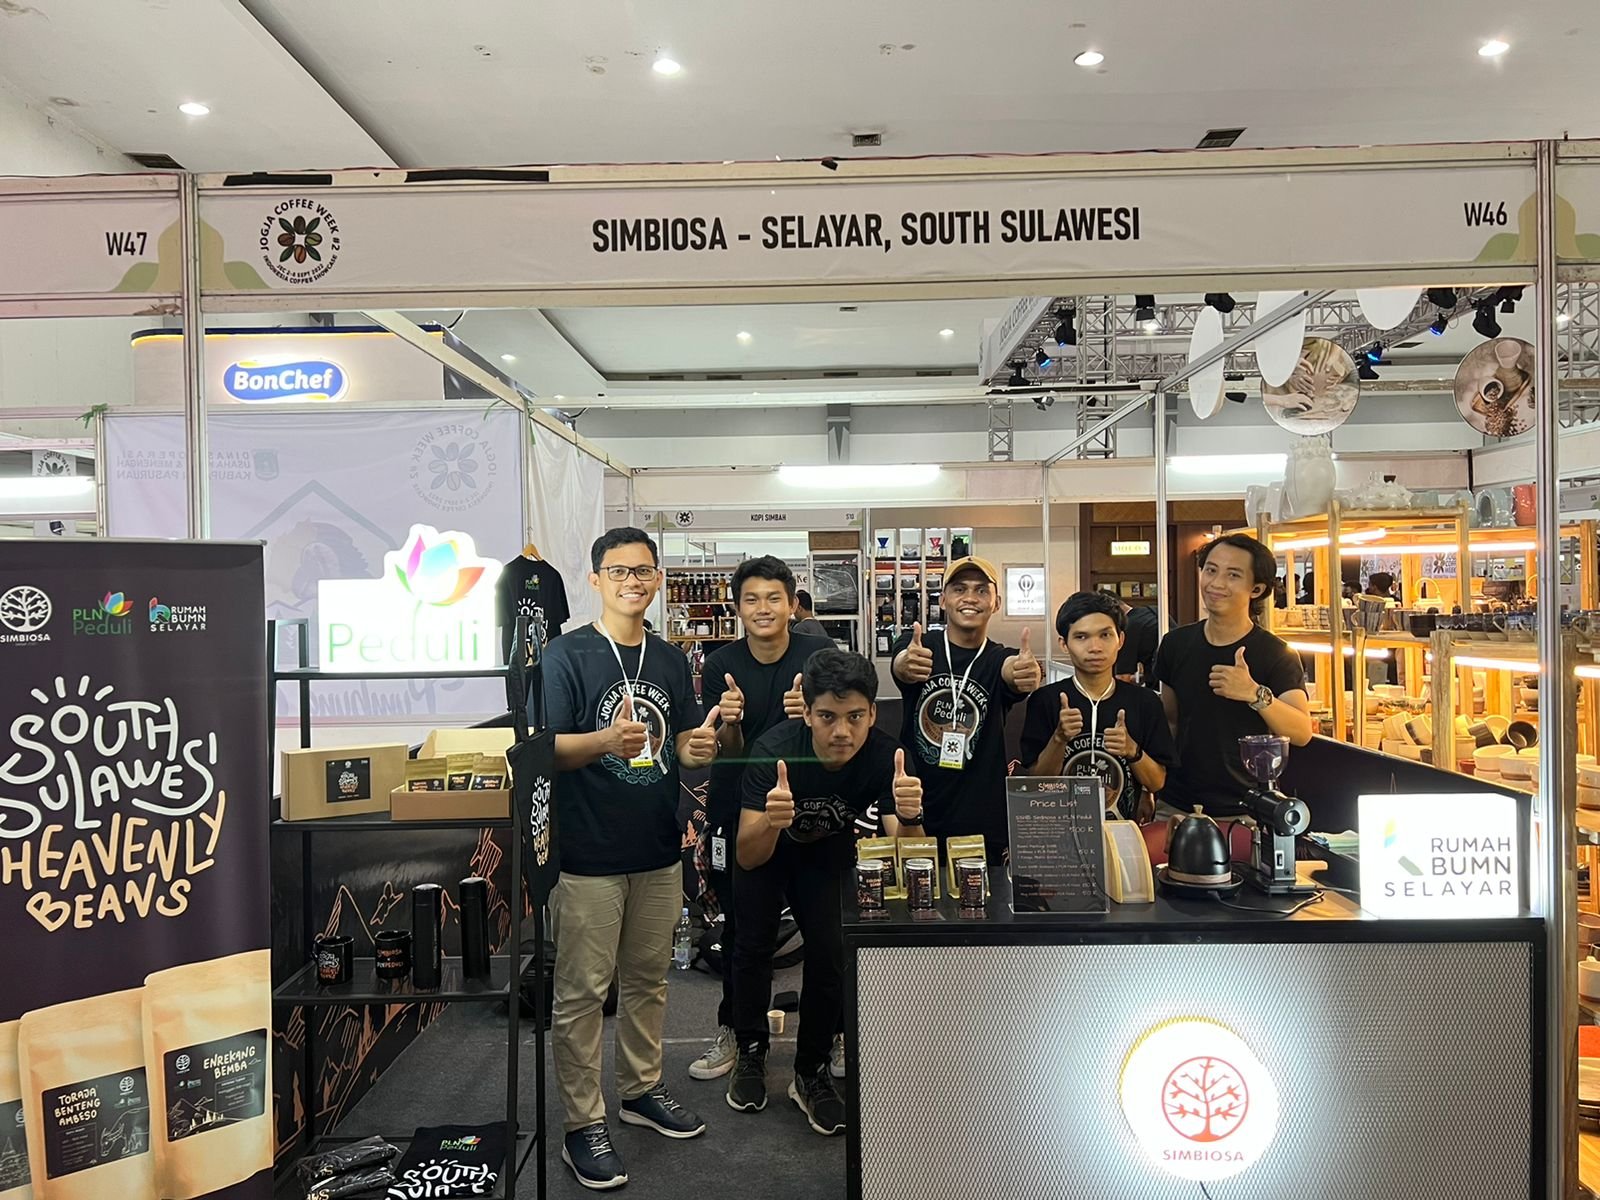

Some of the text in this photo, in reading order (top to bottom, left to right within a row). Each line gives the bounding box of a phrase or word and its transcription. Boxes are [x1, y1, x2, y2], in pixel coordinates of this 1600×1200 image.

[1464, 201, 1507, 227] W46
[260, 198, 340, 251] JOGJA COFFEE WEEK #2
[592, 217, 728, 252] SIMBIOSA
[761, 214, 892, 253] SELAYAR,
[900, 210, 991, 246] SOUTH
[1001, 207, 1141, 243] SULAWESI
[106, 232, 148, 256] W47
[263, 255, 289, 281] INDONESIA
[314, 255, 338, 280] SHOWCASE
[233, 368, 333, 390] BonChef
[751, 513, 787, 522] KOPI SIMBAH
[73, 608, 103, 621] PLN
[171, 606, 206, 614] RUMAH
[171, 614, 206, 623] BUMN
[73, 617, 132, 635] Peduli
[150, 622, 206, 632] SELAYAR
[0, 633, 51, 643] SIMBIOSA
[328, 617, 479, 663] Peduli
[600, 684, 671, 720] JOGJA COFEE WEEK
[966, 682, 988, 706] WEEK
[935, 700, 952, 710] PLN
[0, 697, 179, 785] SOUTH
[0, 732, 217, 839] SULAWESI
[1030, 799, 1078, 808] Price List
[2, 790, 226, 890] HEAVENLY
[1431, 837, 1511, 853] RUMAH
[1432, 856, 1511, 876] BUMN
[1384, 880, 1511, 897] SELAYAR
[26, 872, 191, 932] BEANS
[203, 1046, 256, 1069] ENREKANG
[214, 1060, 248, 1079] BEMBA
[58, 1087, 97, 1105] TORAJA
[54, 1098, 101, 1118] BENTENG
[59, 1109, 97, 1126] AMBESO
[441, 1138, 461, 1147] PLN
[1162, 1149, 1244, 1161] SIMBIOSA
[403, 1162, 489, 1187] SOUTH
